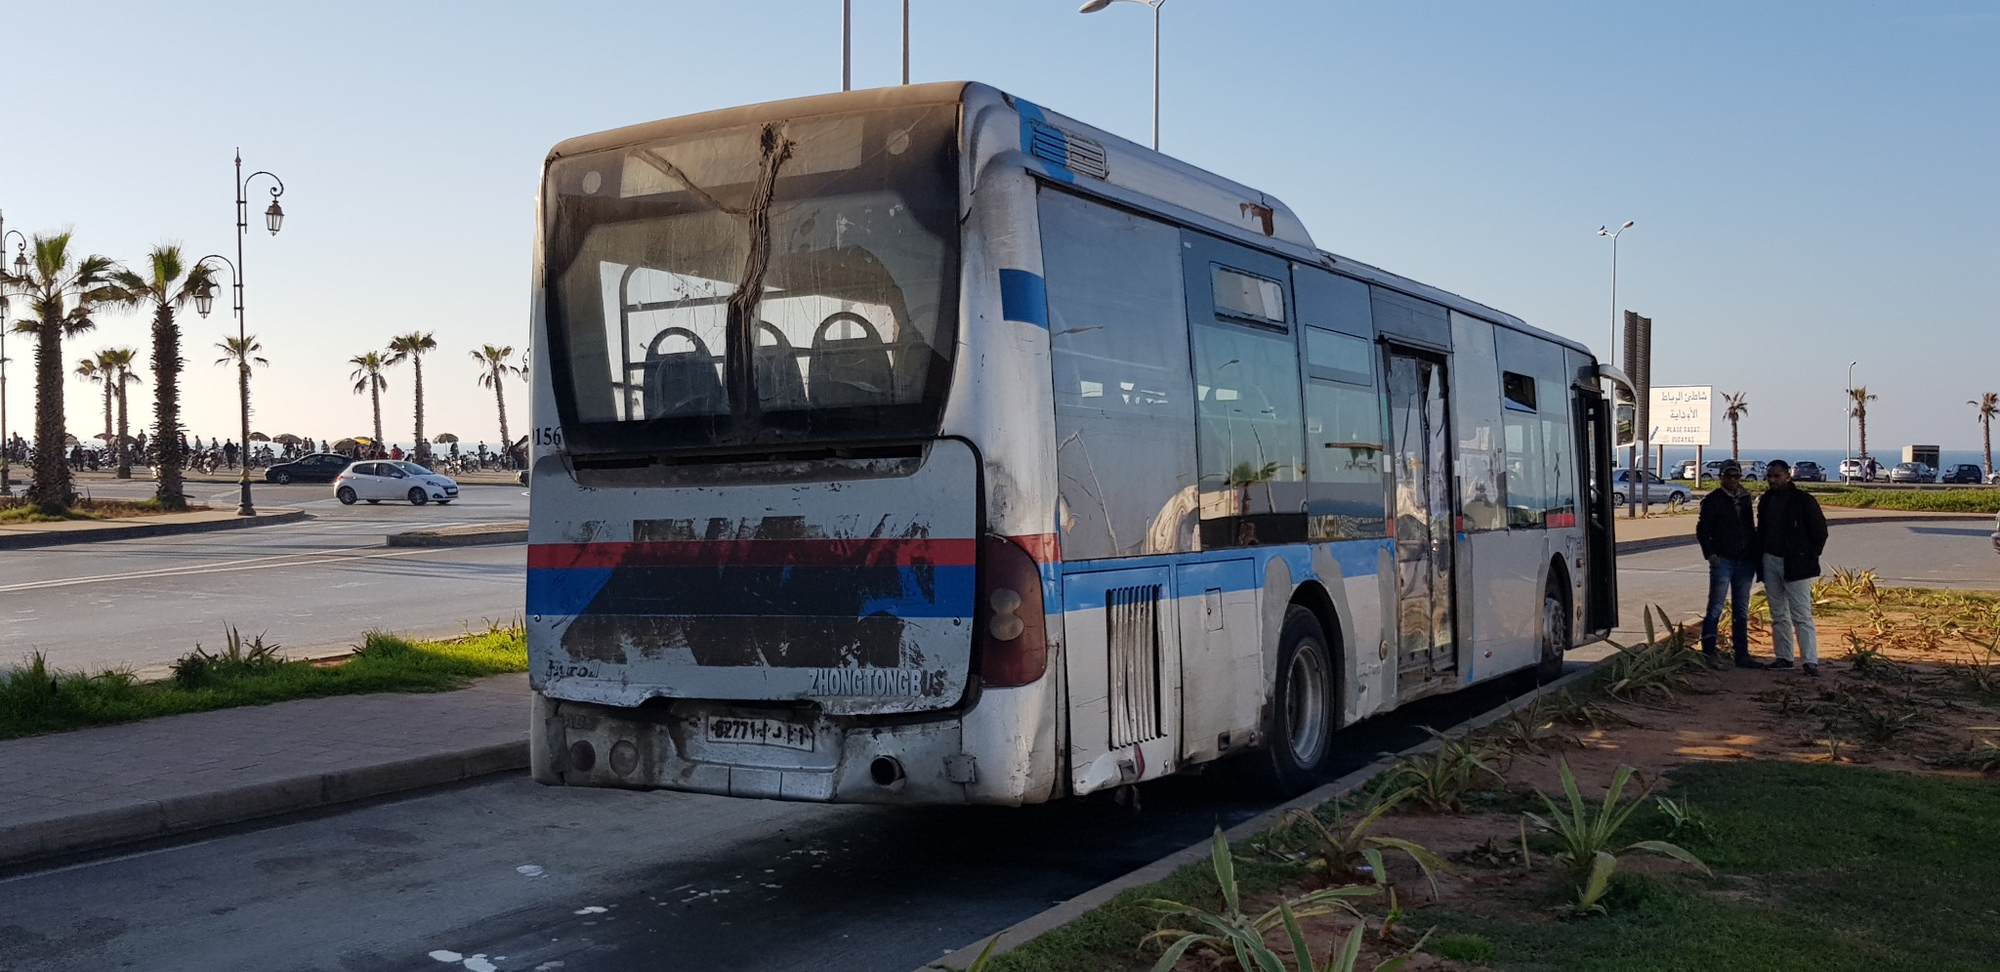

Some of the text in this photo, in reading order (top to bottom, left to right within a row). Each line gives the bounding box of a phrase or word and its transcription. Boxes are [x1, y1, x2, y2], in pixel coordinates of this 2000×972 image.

[1661, 391, 1707, 405] شاطئ الرباط
[532, 427, 561, 446] 156
